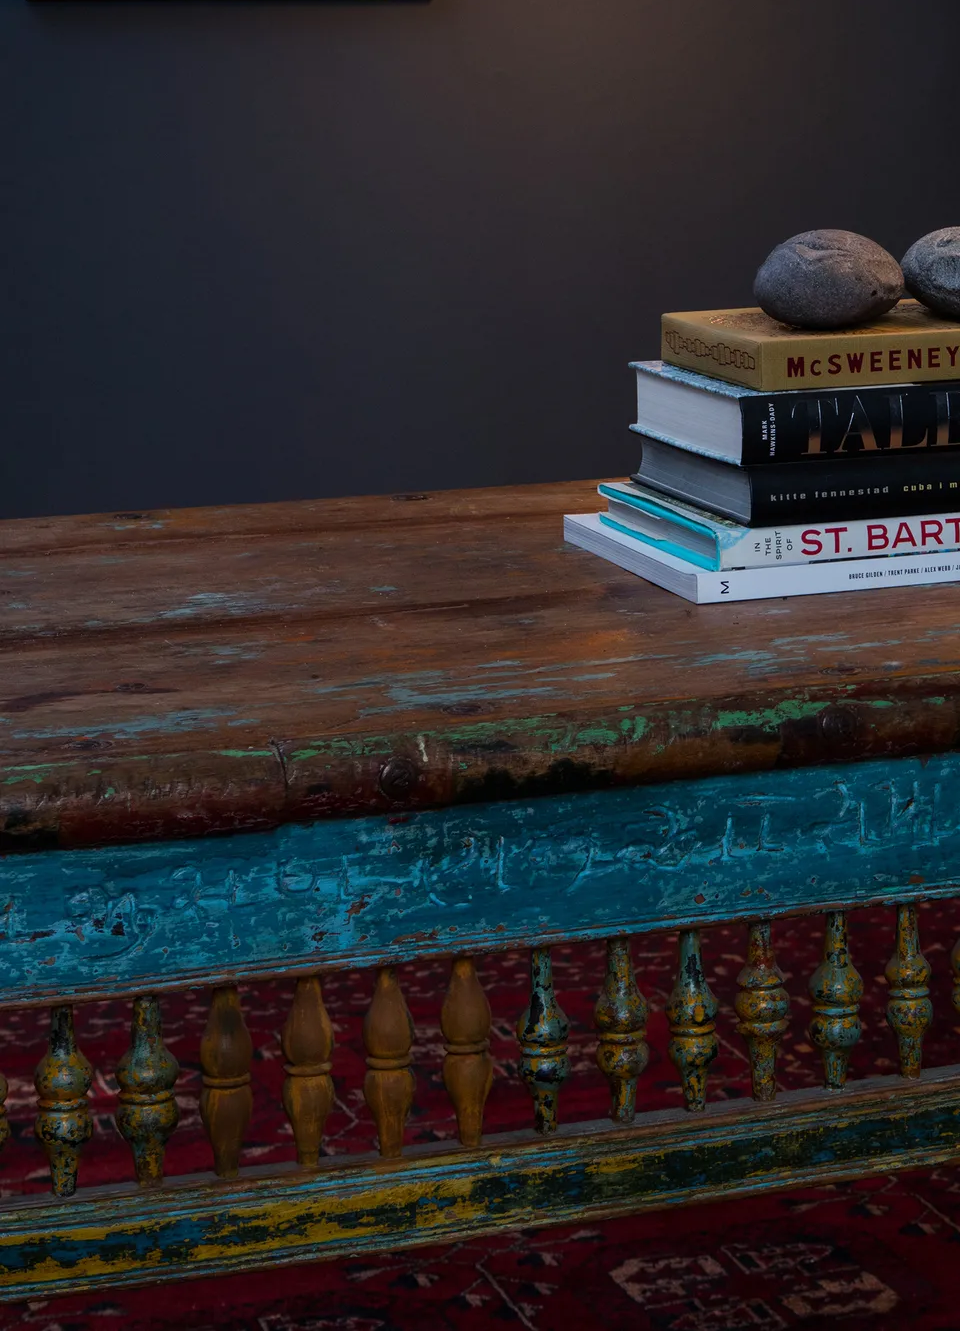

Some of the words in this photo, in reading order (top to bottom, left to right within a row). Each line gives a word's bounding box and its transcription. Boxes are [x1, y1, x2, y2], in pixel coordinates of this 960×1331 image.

[770, 492, 806, 502] kitte
[814, 485, 889, 499] fennestad
[903, 482, 932, 492] cuba
[754, 542, 761, 552] IN
[786, 538, 793, 551] OF
[801, 526, 852, 556] ST.
[848, 572, 864, 580] BRUCE
[865, 570, 883, 578] GILDEN
[904, 567, 920, 575] PARKE
